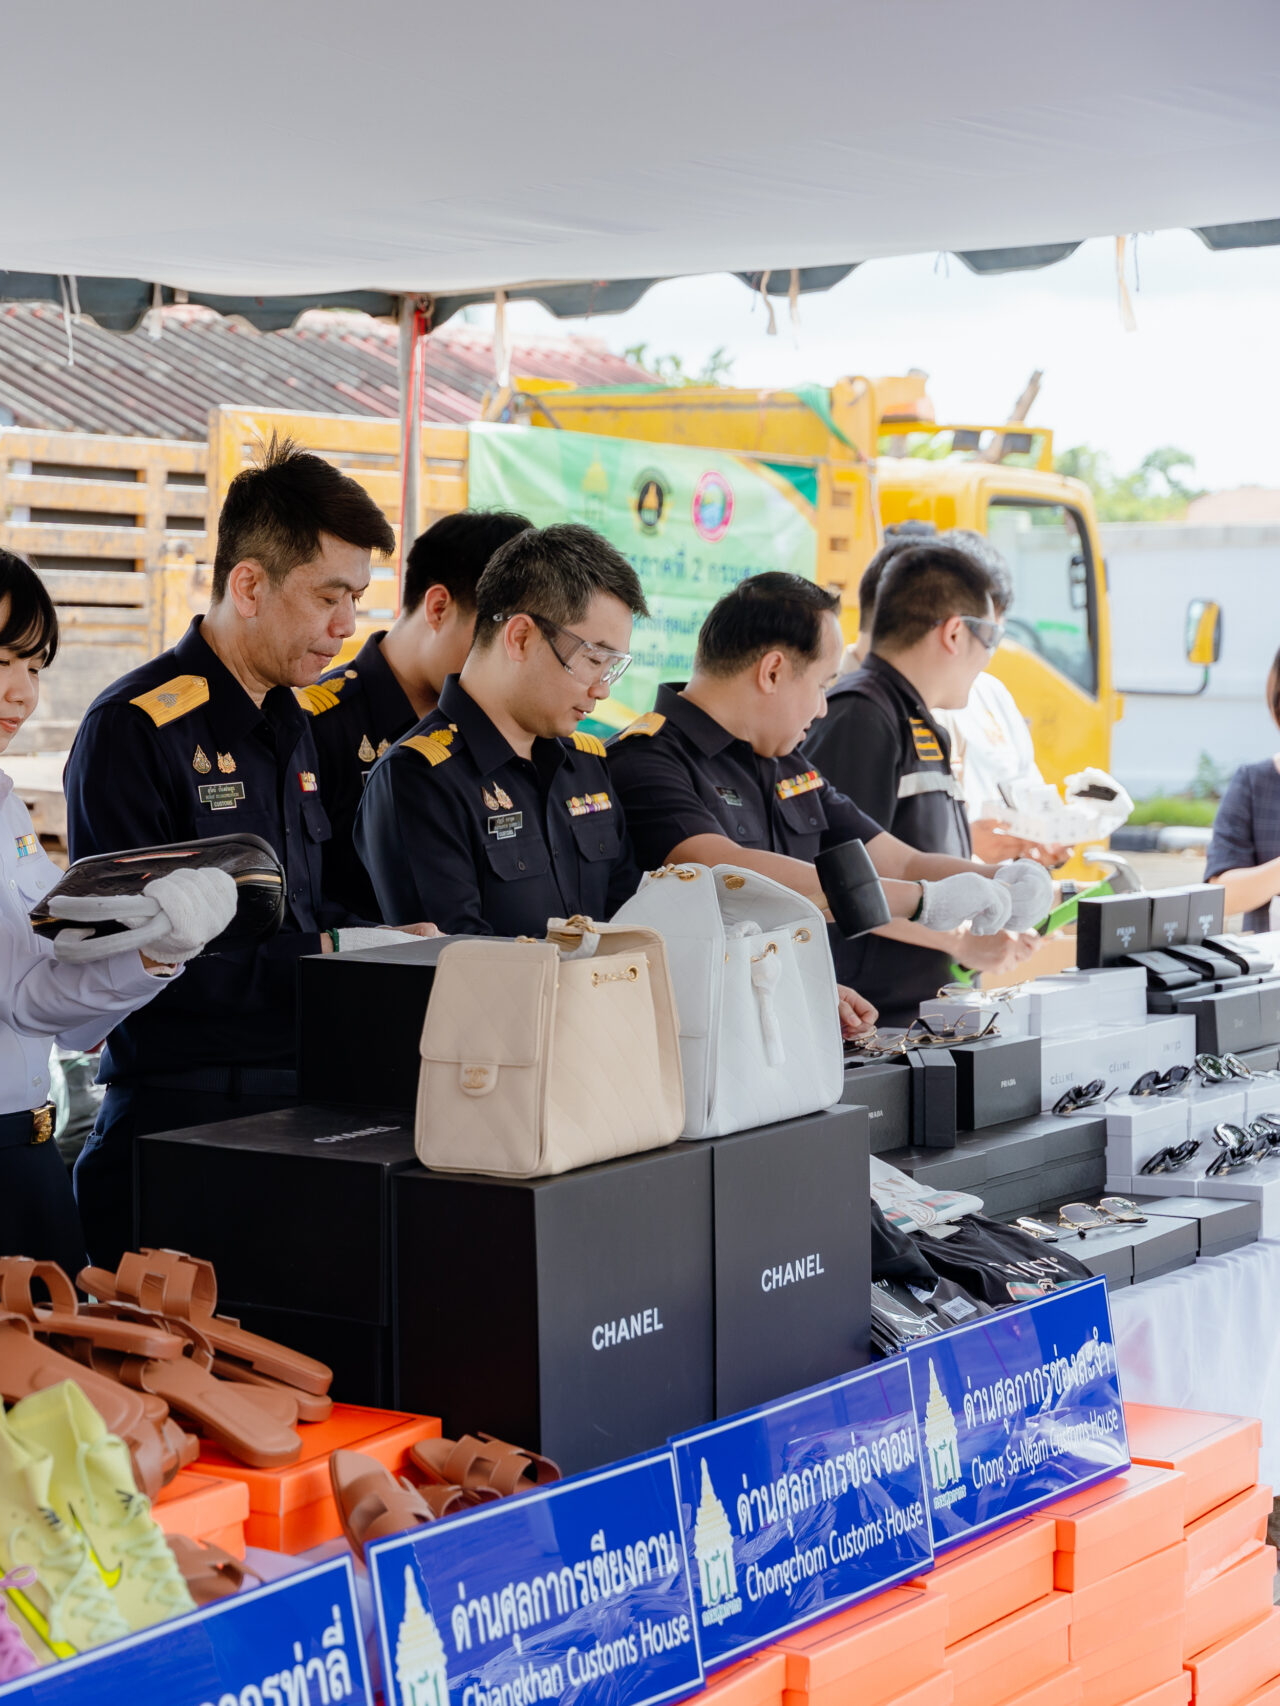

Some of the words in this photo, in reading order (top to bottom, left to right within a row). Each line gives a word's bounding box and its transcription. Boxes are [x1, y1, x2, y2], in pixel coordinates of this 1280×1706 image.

[313, 1126, 401, 1144] CHANEL
[761, 1252, 825, 1292] CHANEL
[591, 1306, 664, 1351] CHANEL
[736, 1426, 916, 1538] ด่านศุลกากรช่องจอม
[971, 1455, 1006, 1490] Chong
[1006, 1436, 1049, 1475] Sa-Ngam
[1089, 1408, 1119, 1439] House
[745, 1545, 828, 1602] Chongchom
[829, 1519, 884, 1565] Customs
[884, 1501, 924, 1540] House
[451, 1529, 679, 1655] ด่านศุลกากรเชียงคาน
[566, 1633, 639, 1686] Customs
[639, 1613, 691, 1658] House
